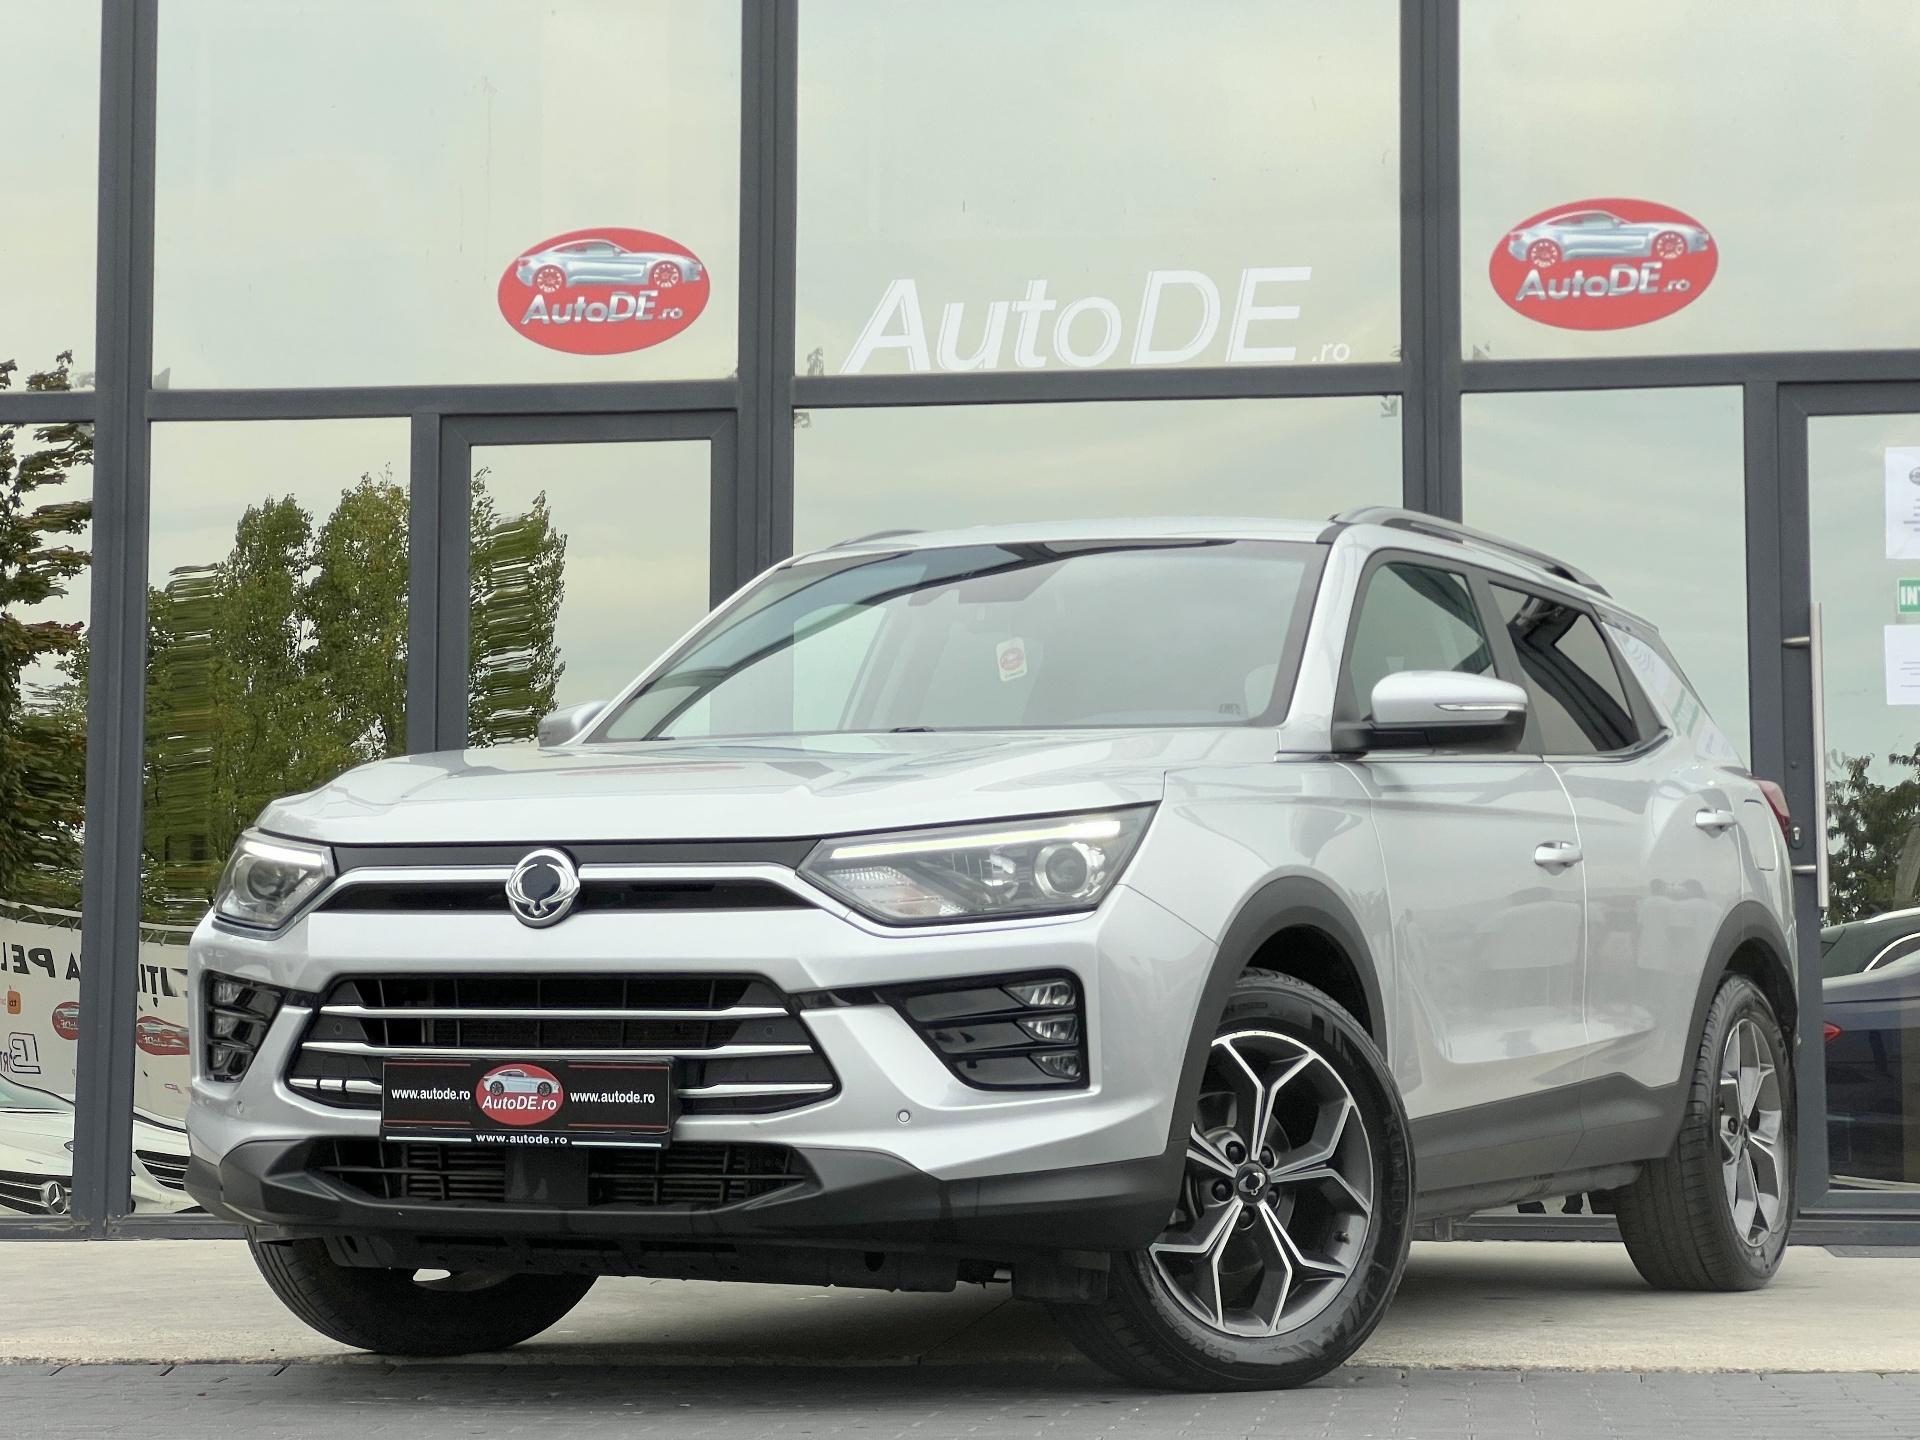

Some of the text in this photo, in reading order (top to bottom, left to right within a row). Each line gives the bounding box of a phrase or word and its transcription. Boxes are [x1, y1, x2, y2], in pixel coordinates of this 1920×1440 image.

[1900, 586, 1920, 605] IN
[391, 1087, 471, 1101] www.autode.ro
[570, 1090, 656, 1104] www.autode.ro
[481, 1095, 557, 1111] AutoDE.ro
[475, 1132, 568, 1145] www.autode.ro
